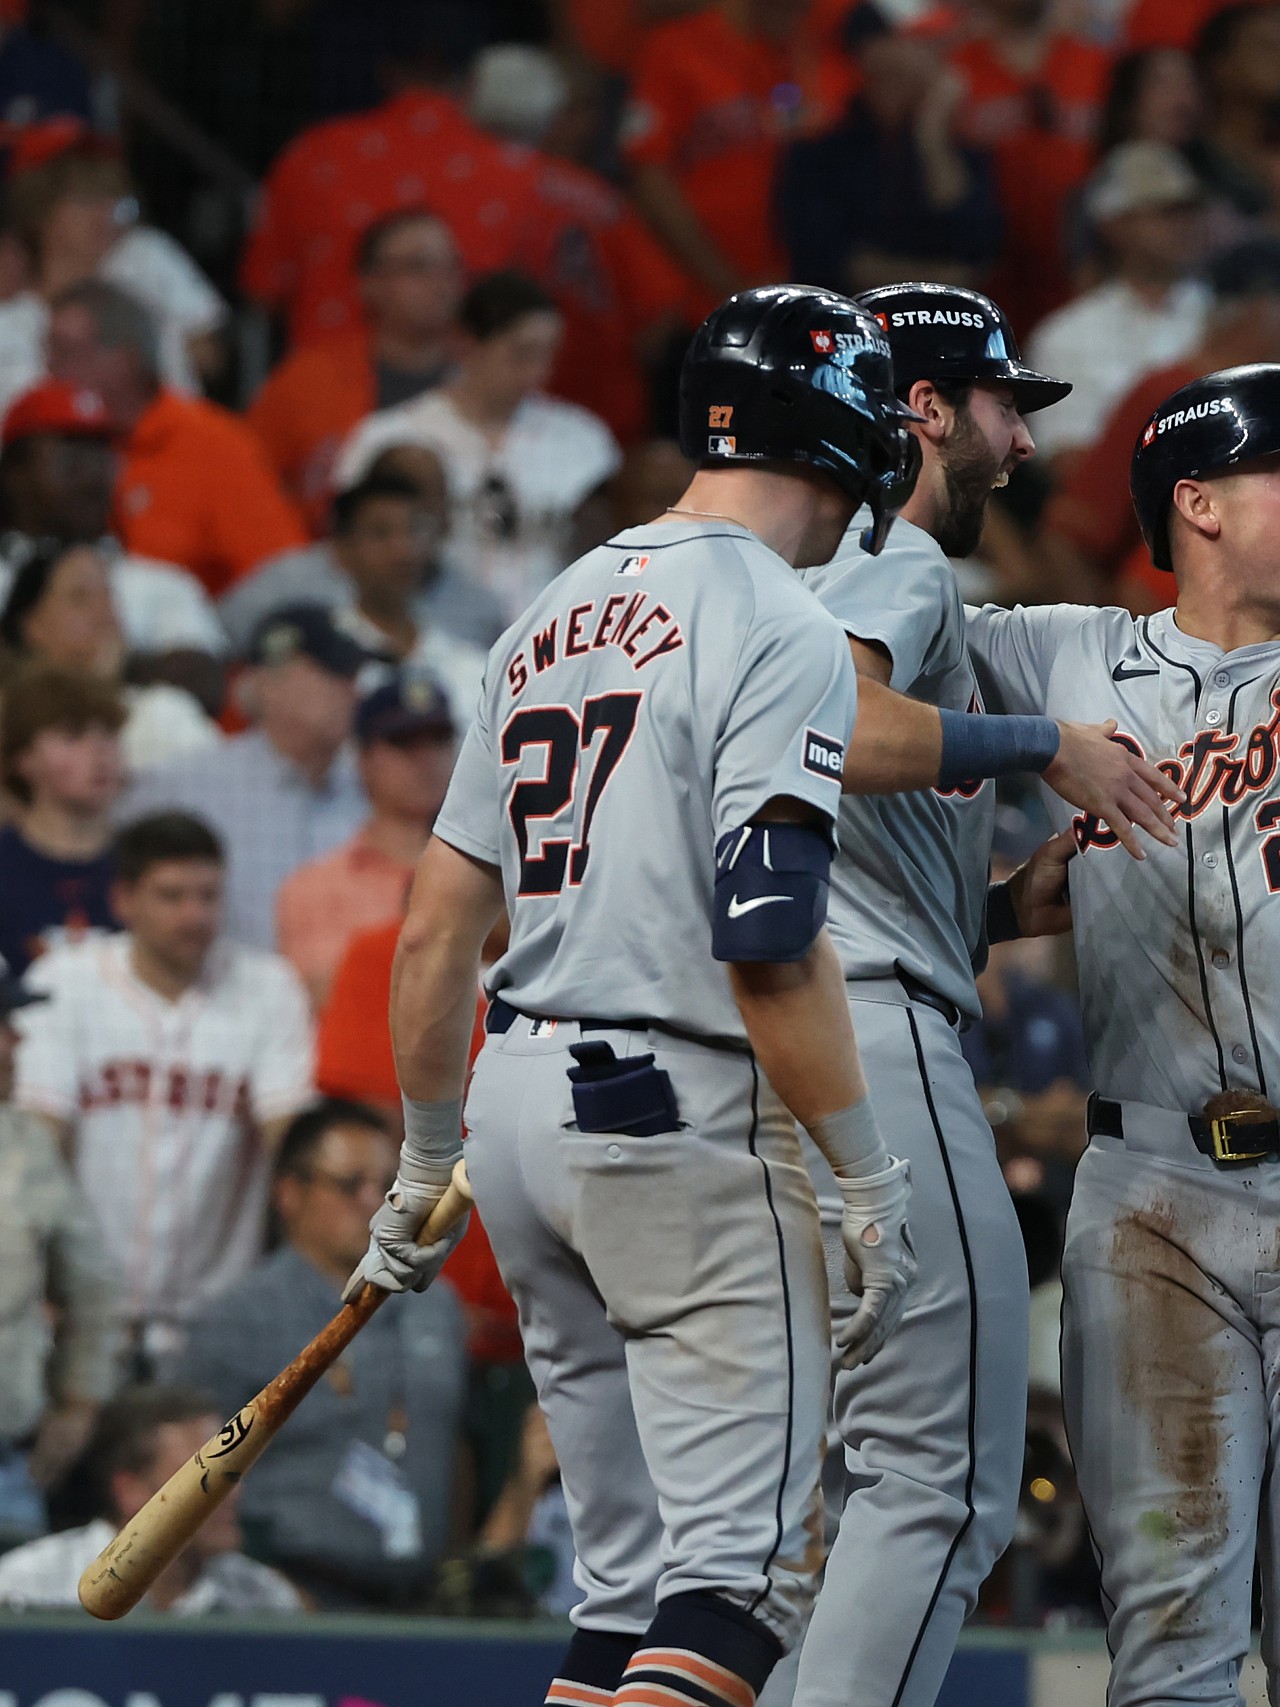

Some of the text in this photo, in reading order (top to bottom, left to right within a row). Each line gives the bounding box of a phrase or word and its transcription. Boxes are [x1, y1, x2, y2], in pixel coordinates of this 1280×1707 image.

[891, 311, 985, 329] STRAUSS
[834, 332, 892, 359] STRAUSS
[708, 405, 734, 429] 27
[1157, 397, 1234, 435] STRAUSS
[507, 589, 687, 698] SWEENEY
[499, 688, 645, 901] 27
